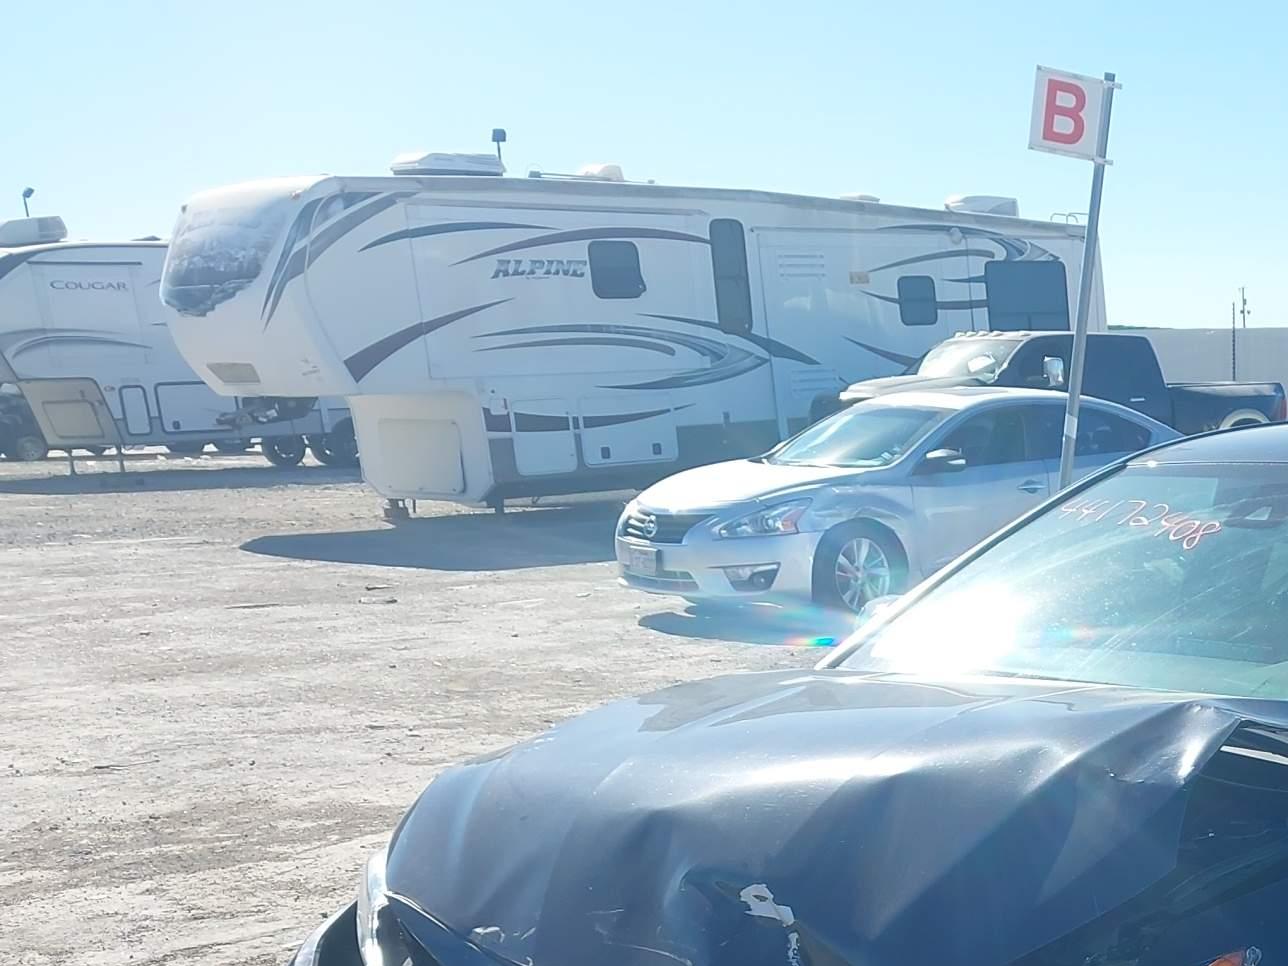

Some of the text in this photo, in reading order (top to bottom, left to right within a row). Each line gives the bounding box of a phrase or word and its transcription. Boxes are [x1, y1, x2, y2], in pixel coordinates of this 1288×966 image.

[1042, 78, 1086, 145] B
[490, 259, 587, 279] ALPINE
[49, 279, 128, 291] COUGAR
